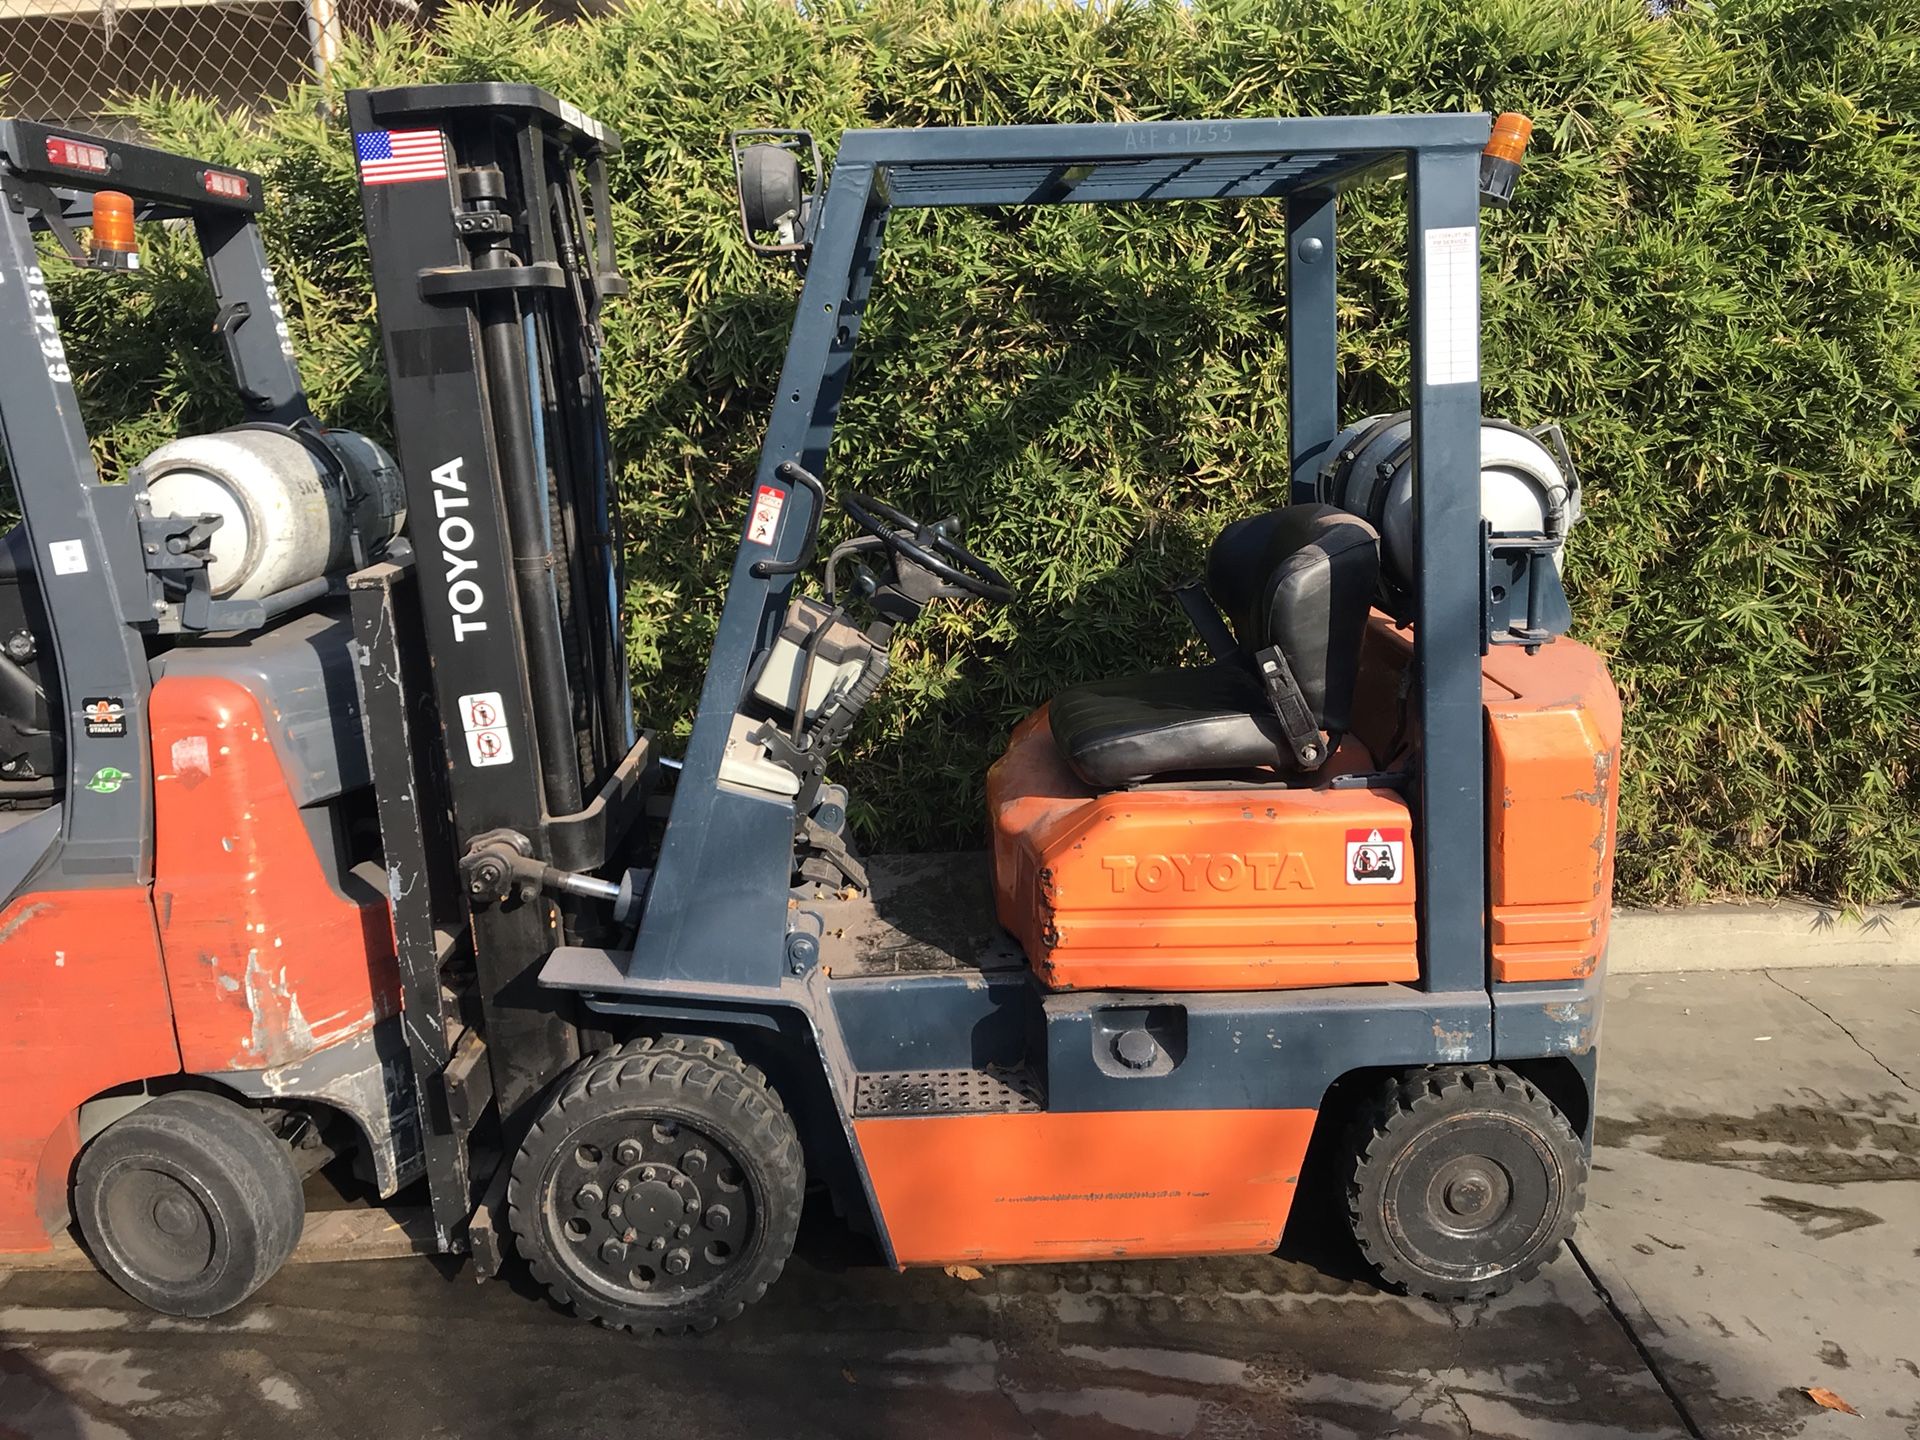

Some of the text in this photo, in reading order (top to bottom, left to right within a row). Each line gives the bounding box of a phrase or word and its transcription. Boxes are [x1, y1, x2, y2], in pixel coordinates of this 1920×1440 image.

[1186, 124, 1232, 145] 1255
[24, 266, 72, 383] 68436
[260, 267, 294, 355] 68436
[430, 455, 488, 643] TOYOTA
[89, 726, 123, 734] STABILITY
[1102, 851, 1316, 894] TOYOTA
